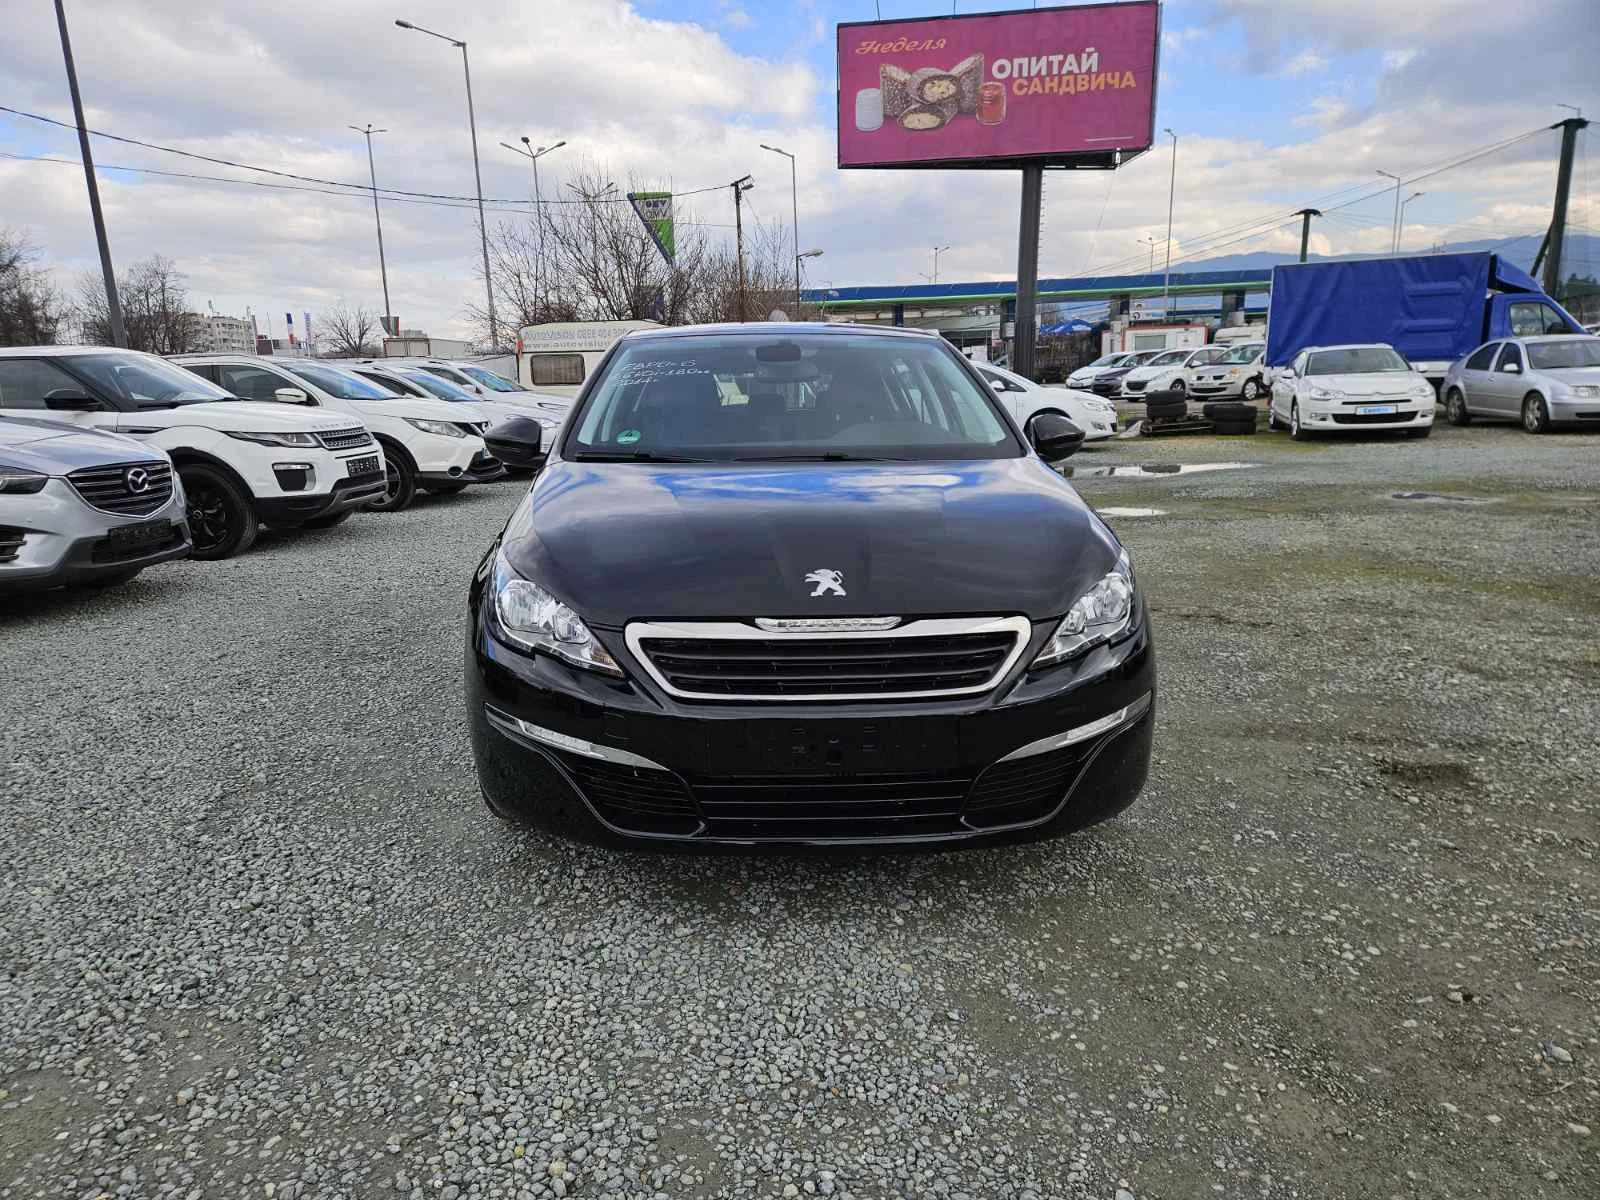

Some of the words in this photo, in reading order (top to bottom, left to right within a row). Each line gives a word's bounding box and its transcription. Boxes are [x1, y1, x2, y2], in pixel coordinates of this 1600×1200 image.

[855, 36, 947, 55] Неделя
[992, 47, 1099, 79] ОПИТАЙ
[1012, 71, 1136, 96] САНДВИЧА
